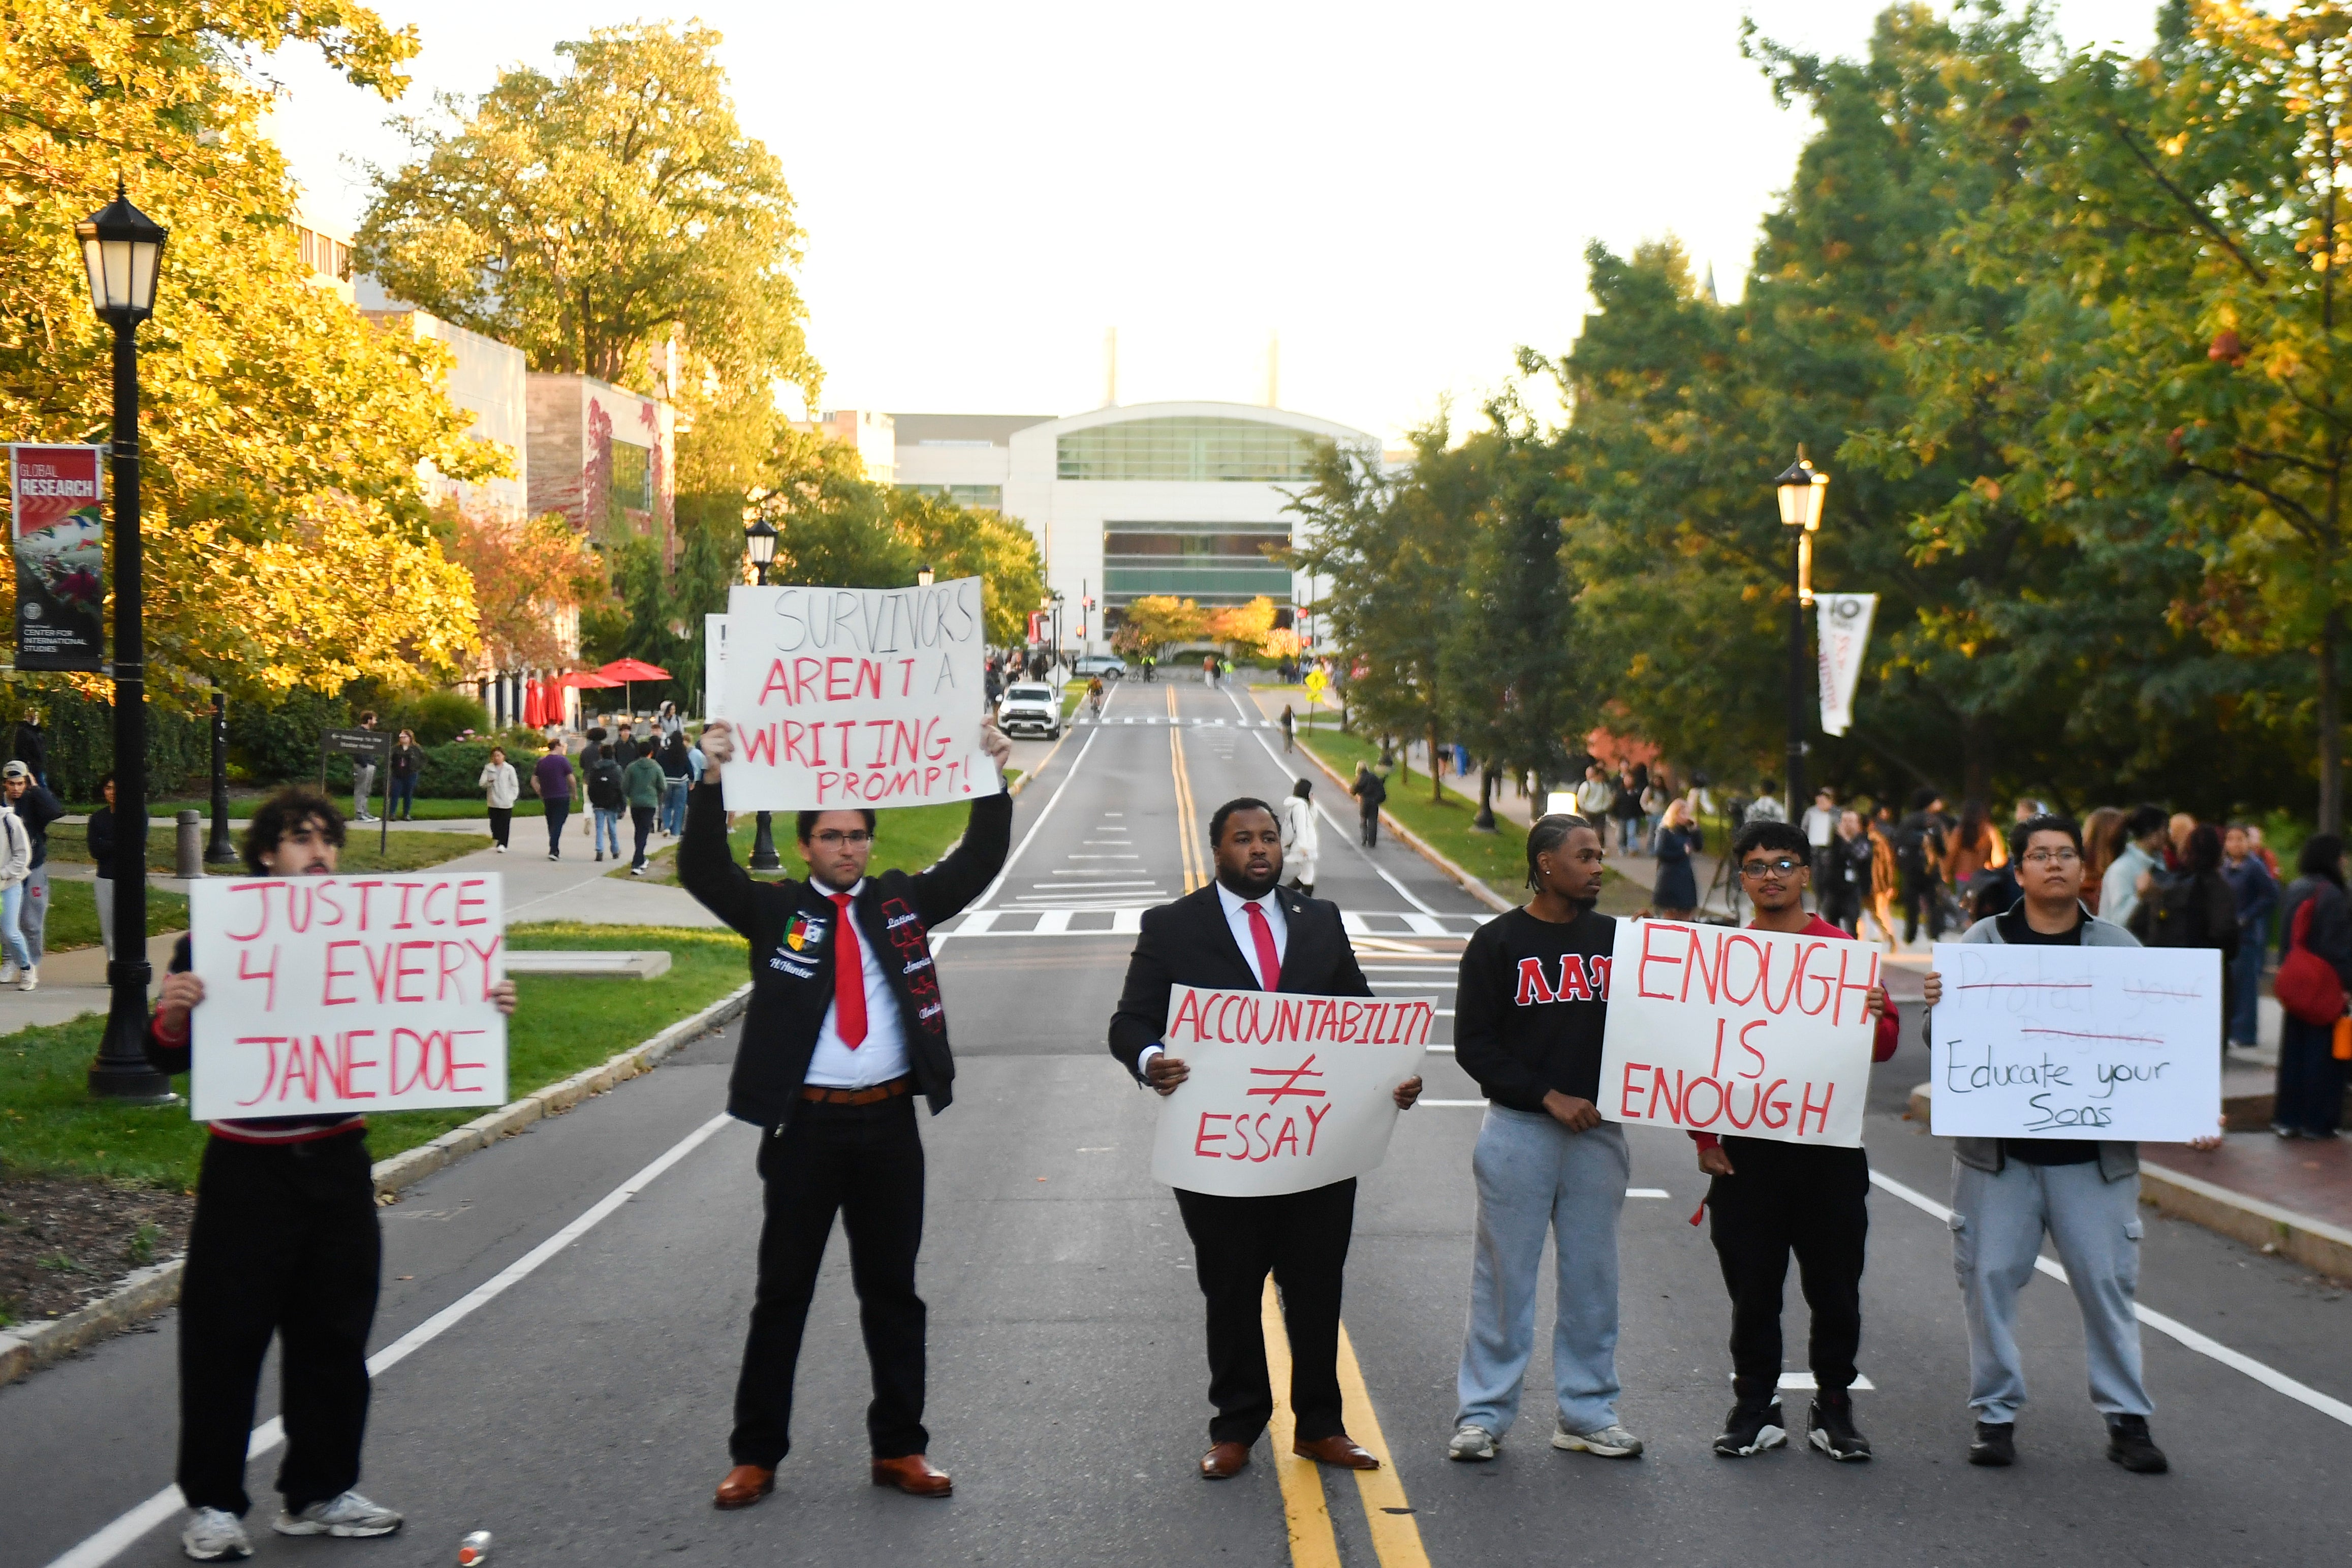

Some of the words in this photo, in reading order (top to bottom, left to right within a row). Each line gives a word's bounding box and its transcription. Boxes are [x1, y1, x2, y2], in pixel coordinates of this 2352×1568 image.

[20, 464, 58, 478] GLOBAL
[20, 479, 93, 497] RESEARCH
[775, 583, 973, 654] SURVIVORS
[758, 655, 915, 707] AREN'T
[934, 652, 955, 695] A
[736, 716, 951, 769] WRITING
[816, 756, 972, 805] PROMPT!
[226, 880, 487, 942] JUSTICE
[887, 913, 916, 929] Latino
[237, 944, 280, 1012] 4
[322, 935, 503, 1006] EVERY
[780, 961, 816, 979] Hunter
[1637, 922, 1877, 1027] ENOUGH
[1958, 949, 2100, 1015] Protect
[2122, 975, 2203, 1019] your
[1169, 989, 1435, 1045] ACCOUNTABILITY
[235, 1030, 377, 1106] JANE
[389, 1027, 486, 1096] DOE
[1711, 1018, 1767, 1079] IS
[1947, 1039, 2073, 1093] Educate
[2088, 1062, 2170, 1099] your
[1620, 1062, 1834, 1136] ENOUGH
[2023, 1093, 2112, 1128] Sons
[1194, 1103, 1331, 1163] ESSAY
